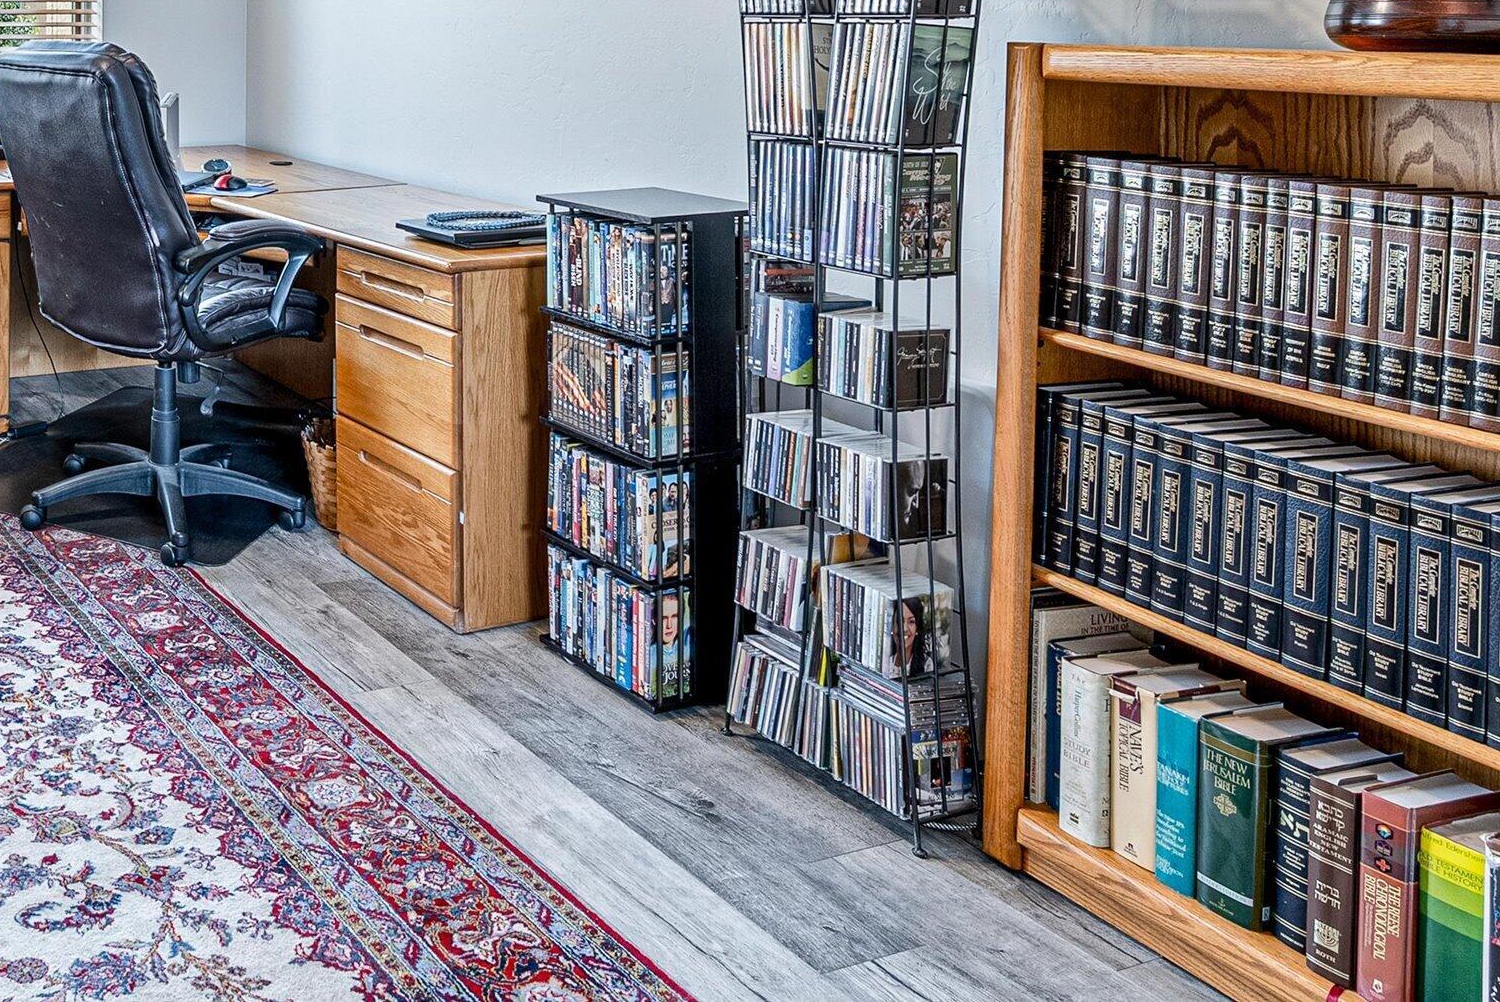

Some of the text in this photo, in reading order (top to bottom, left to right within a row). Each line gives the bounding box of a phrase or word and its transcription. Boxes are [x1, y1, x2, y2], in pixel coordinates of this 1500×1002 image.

[1449, 256, 1463, 334] BIBLICAL LIBRARY
[1338, 530, 1348, 605] BIBLICAL LIBRARY
[1376, 542, 1386, 620] BIBLICAL LIBRARY
[1418, 554, 1429, 633] BIBLICAL LIBRARY
[1458, 565, 1469, 647] BIBLICAL LIBRARY
[1105, 624, 1119, 632] TIME
[1417, 669, 1434, 678] STUDY
[1418, 674, 1432, 683] BIBLE
[1458, 687, 1475, 697] STUDY
[1458, 693, 1473, 703] BIBLE
[1063, 749, 1091, 768] BIBLE
[1064, 737, 1091, 756] STUDY
[1119, 723, 1130, 792] TOPICAL BIBLE
[1129, 725, 1144, 774] NAVE'S
[1206, 749, 1248, 774] THE NEW
[1203, 760, 1251, 789] JERUSALEM
[1214, 775, 1236, 796] BIBLE
[1313, 822, 1349, 843] ARAMAIC
[1314, 829, 1347, 848] ENGLISH
[1309, 840, 1352, 864] TESTAMENT
[1320, 840, 1338, 851] NEW
[1436, 858, 1484, 883] TESTAMEN
[1442, 868, 1483, 891] HISTORY
[1364, 873, 1375, 905] BIBLE
[1373, 879, 1387, 960] CHRONOLOGICAL
[1387, 886, 1401, 937] THE REESE
[1315, 948, 1336, 964] ROTH
